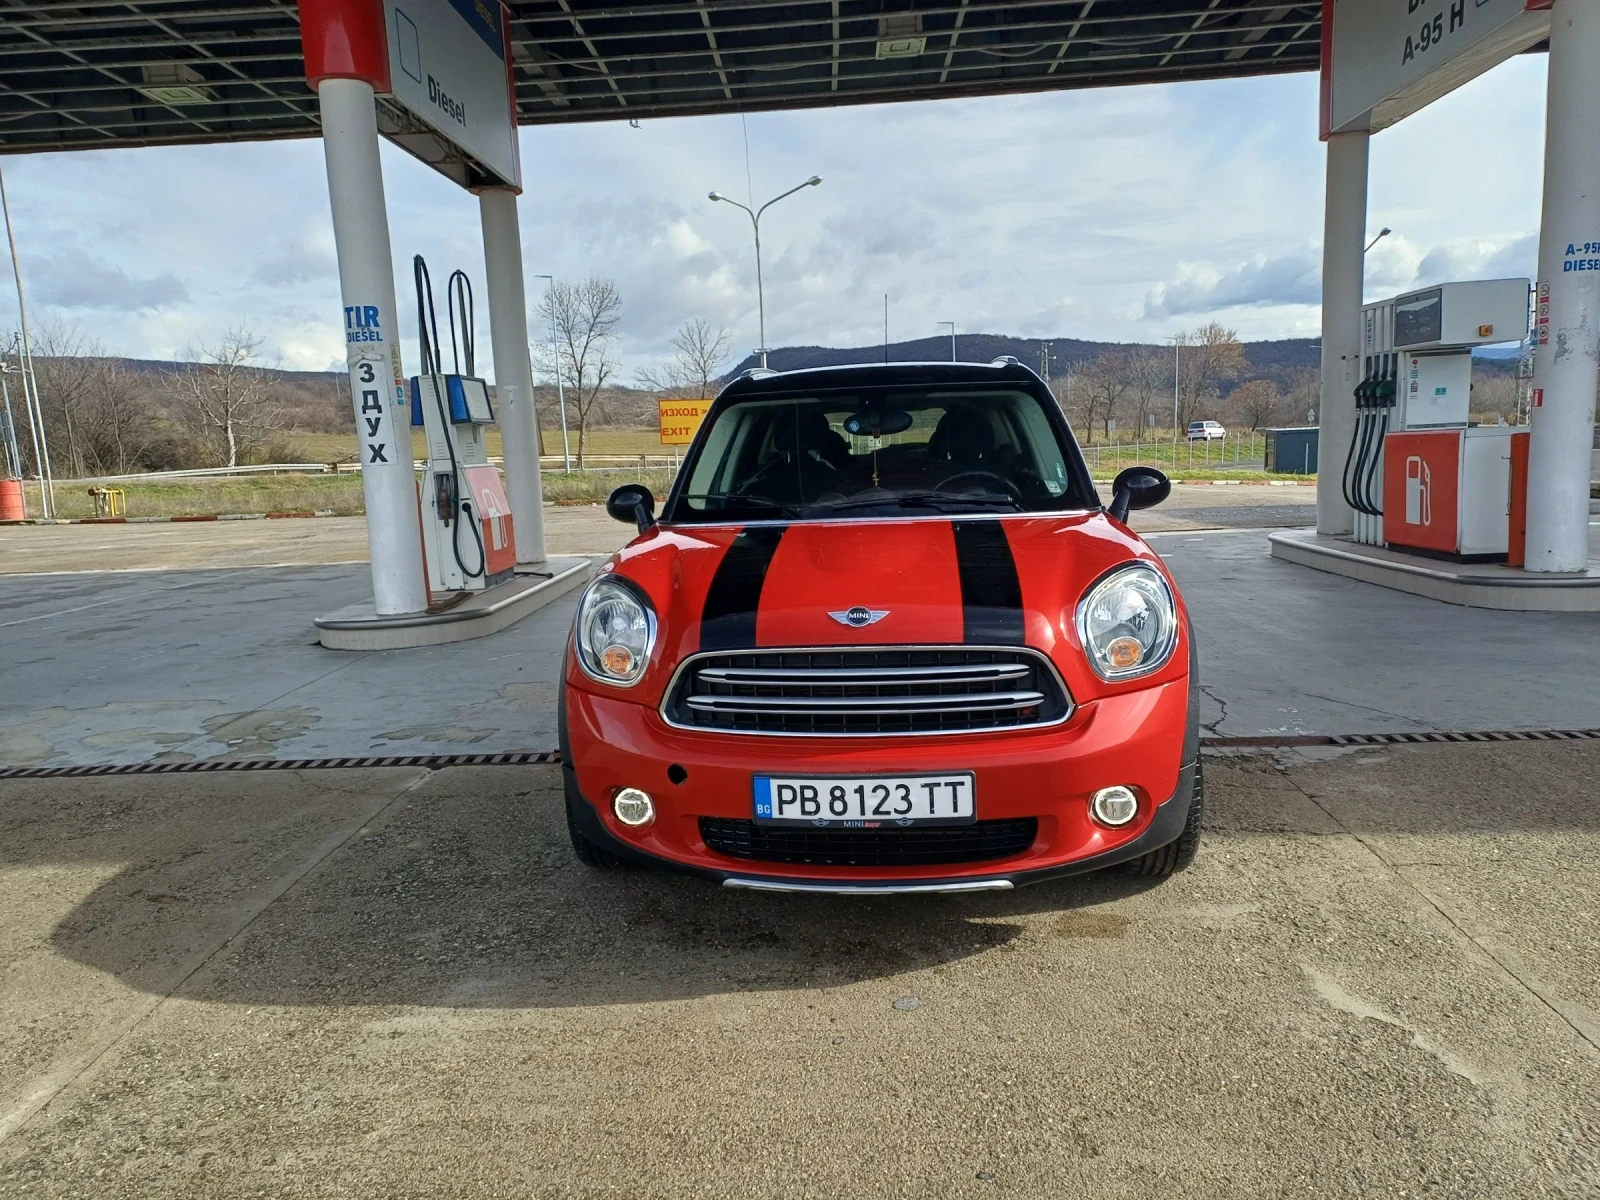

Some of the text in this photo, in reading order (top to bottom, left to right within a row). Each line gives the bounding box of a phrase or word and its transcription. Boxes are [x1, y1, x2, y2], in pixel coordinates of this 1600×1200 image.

[1402, 0, 1465, 67] A-95 H
[427, 73, 467, 128] Diesel
[1563, 258, 1600, 273] DIESE
[344, 305, 380, 329] TIR
[348, 331, 384, 343] DIESEL
[660, 408, 699, 417] ИЗХОД
[662, 427, 691, 436] EXIT
[776, 781, 965, 816] PB 8123 TT
[756, 804, 771, 815] BG
[843, 820, 864, 828] MINI
